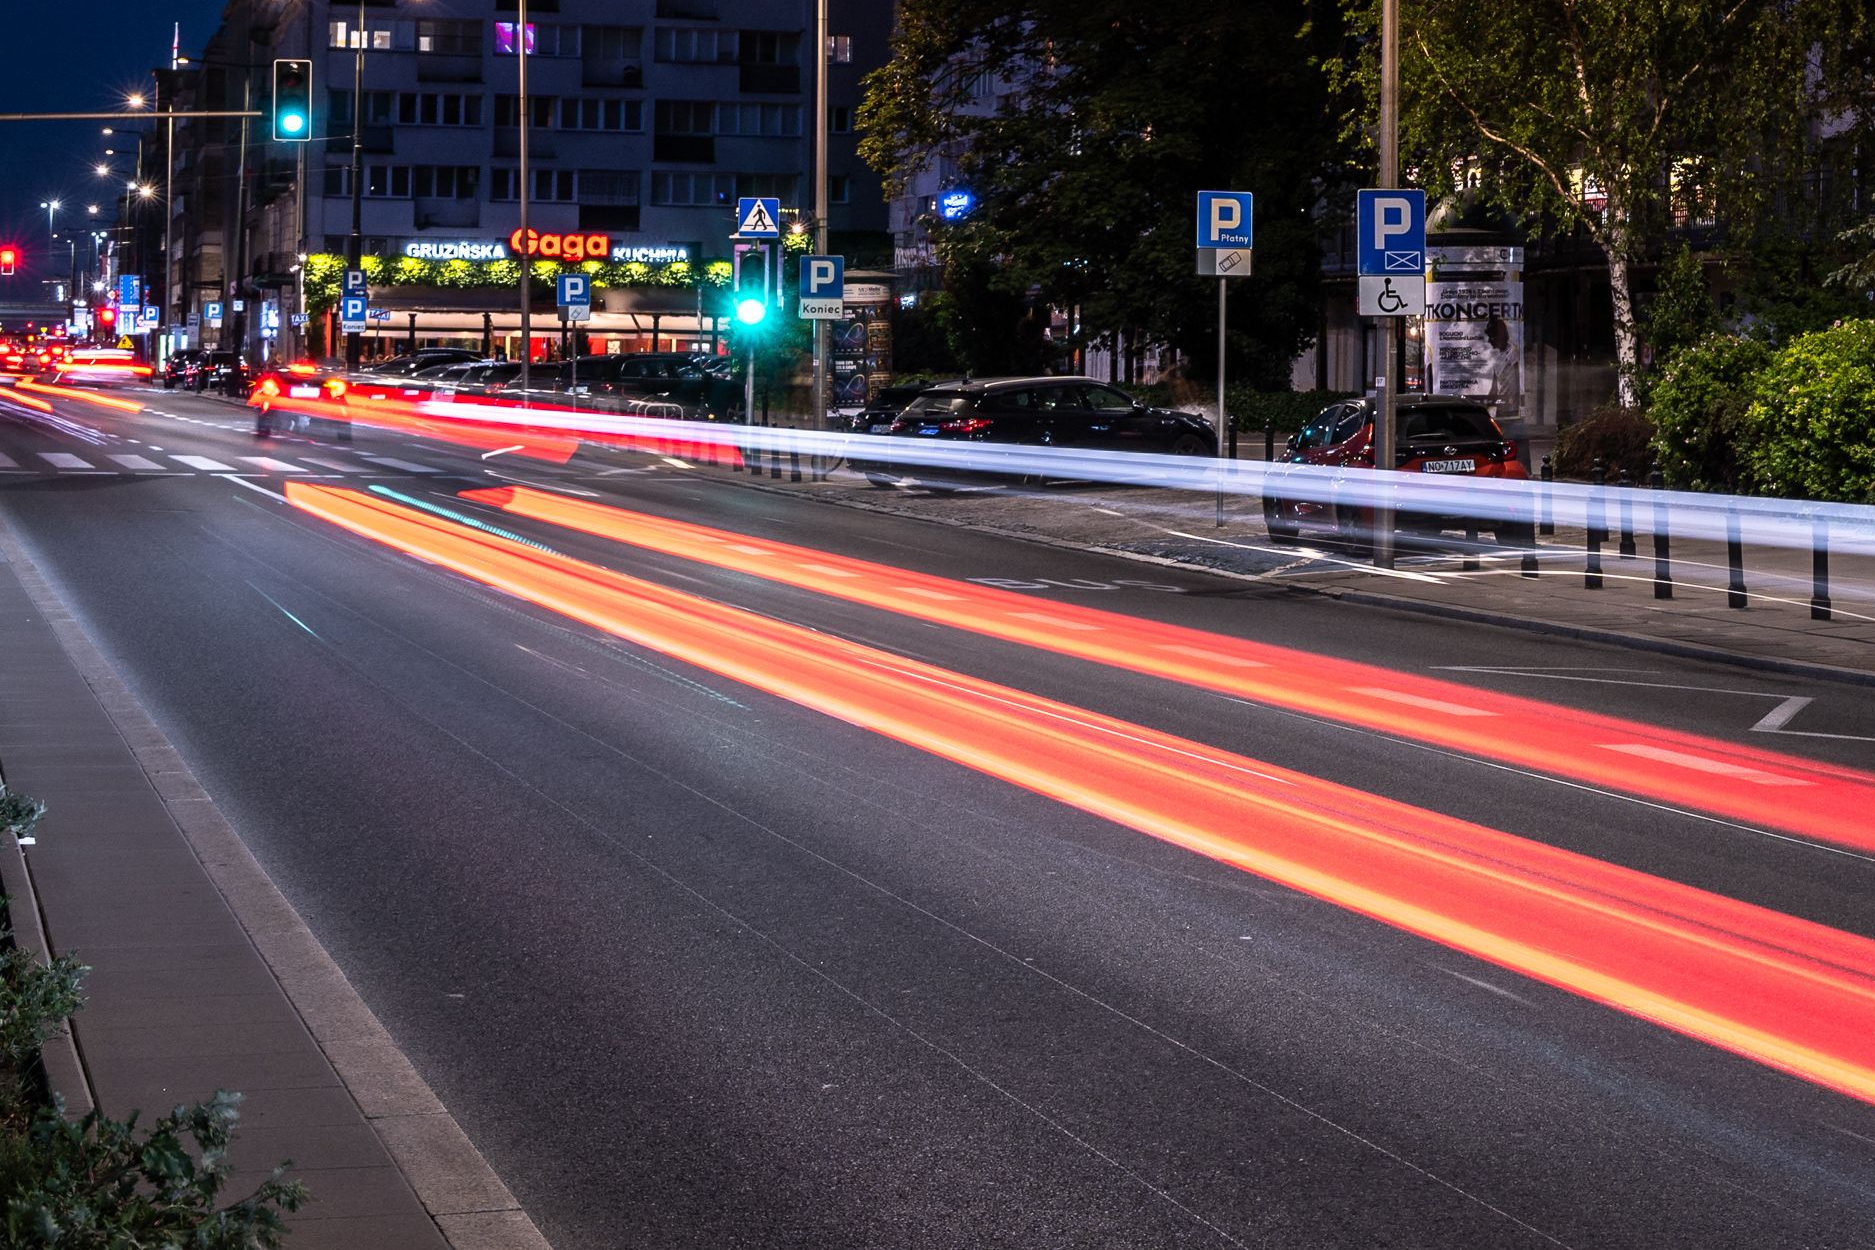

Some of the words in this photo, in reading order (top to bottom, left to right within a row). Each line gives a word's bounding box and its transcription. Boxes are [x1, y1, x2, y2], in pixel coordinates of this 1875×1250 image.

[1211, 198, 1241, 241] P
[1374, 197, 1411, 250] P
[510, 229, 608, 262] Gaga
[1220, 233, 1249, 245] Płatny
[348, 271, 362, 289] P
[810, 260, 835, 293] P
[565, 277, 583, 302] P
[146, 307, 156, 320] P
[208, 303, 220, 317] P
[347, 300, 362, 318] P
[802, 303, 840, 315] Koniec
[291, 314, 309, 323] TAXI
[1444, 461, 1475, 471] 717AY
